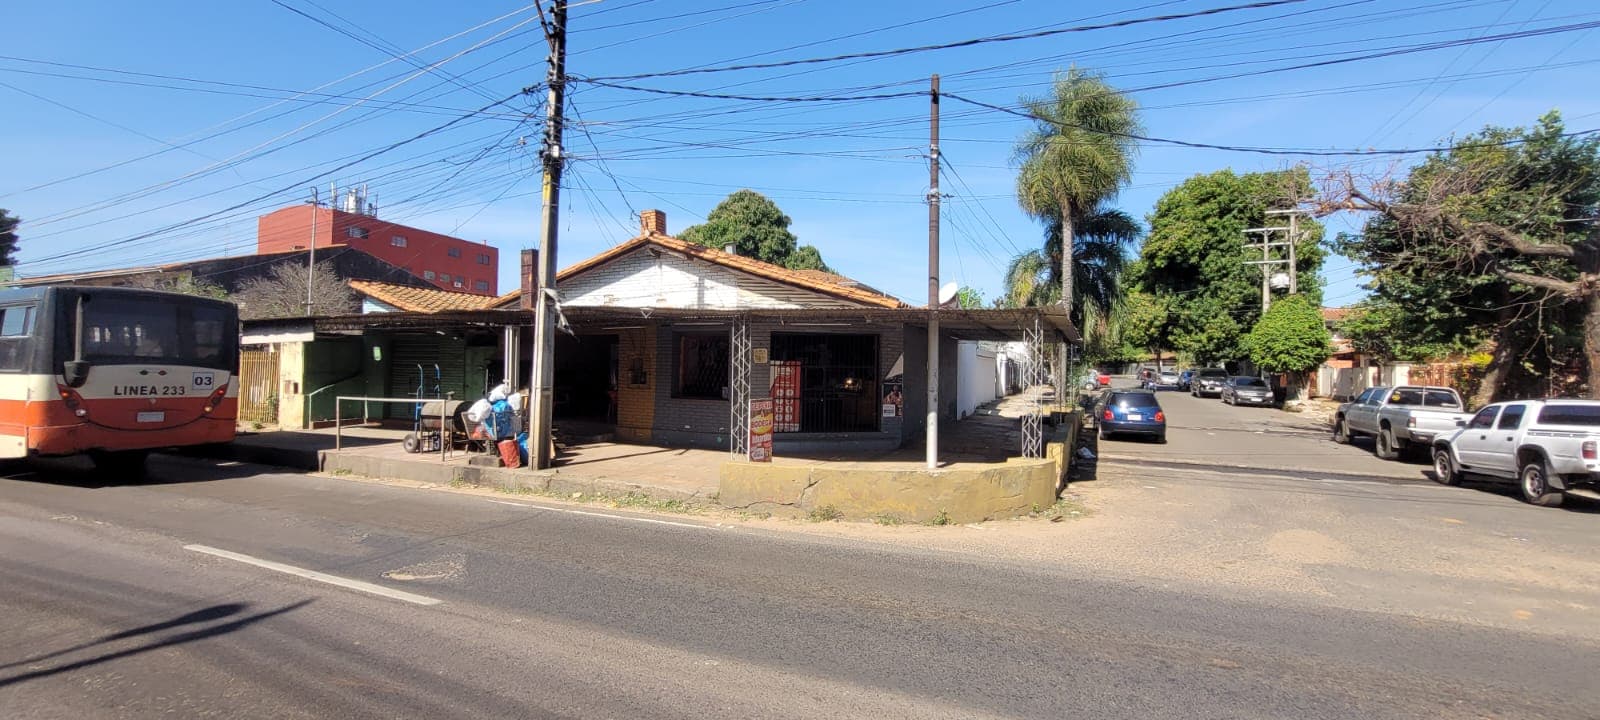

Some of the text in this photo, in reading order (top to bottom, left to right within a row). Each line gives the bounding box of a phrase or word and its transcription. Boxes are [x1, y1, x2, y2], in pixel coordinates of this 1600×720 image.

[194, 376, 212, 386] 03
[114, 385, 185, 396] LINEA 233
